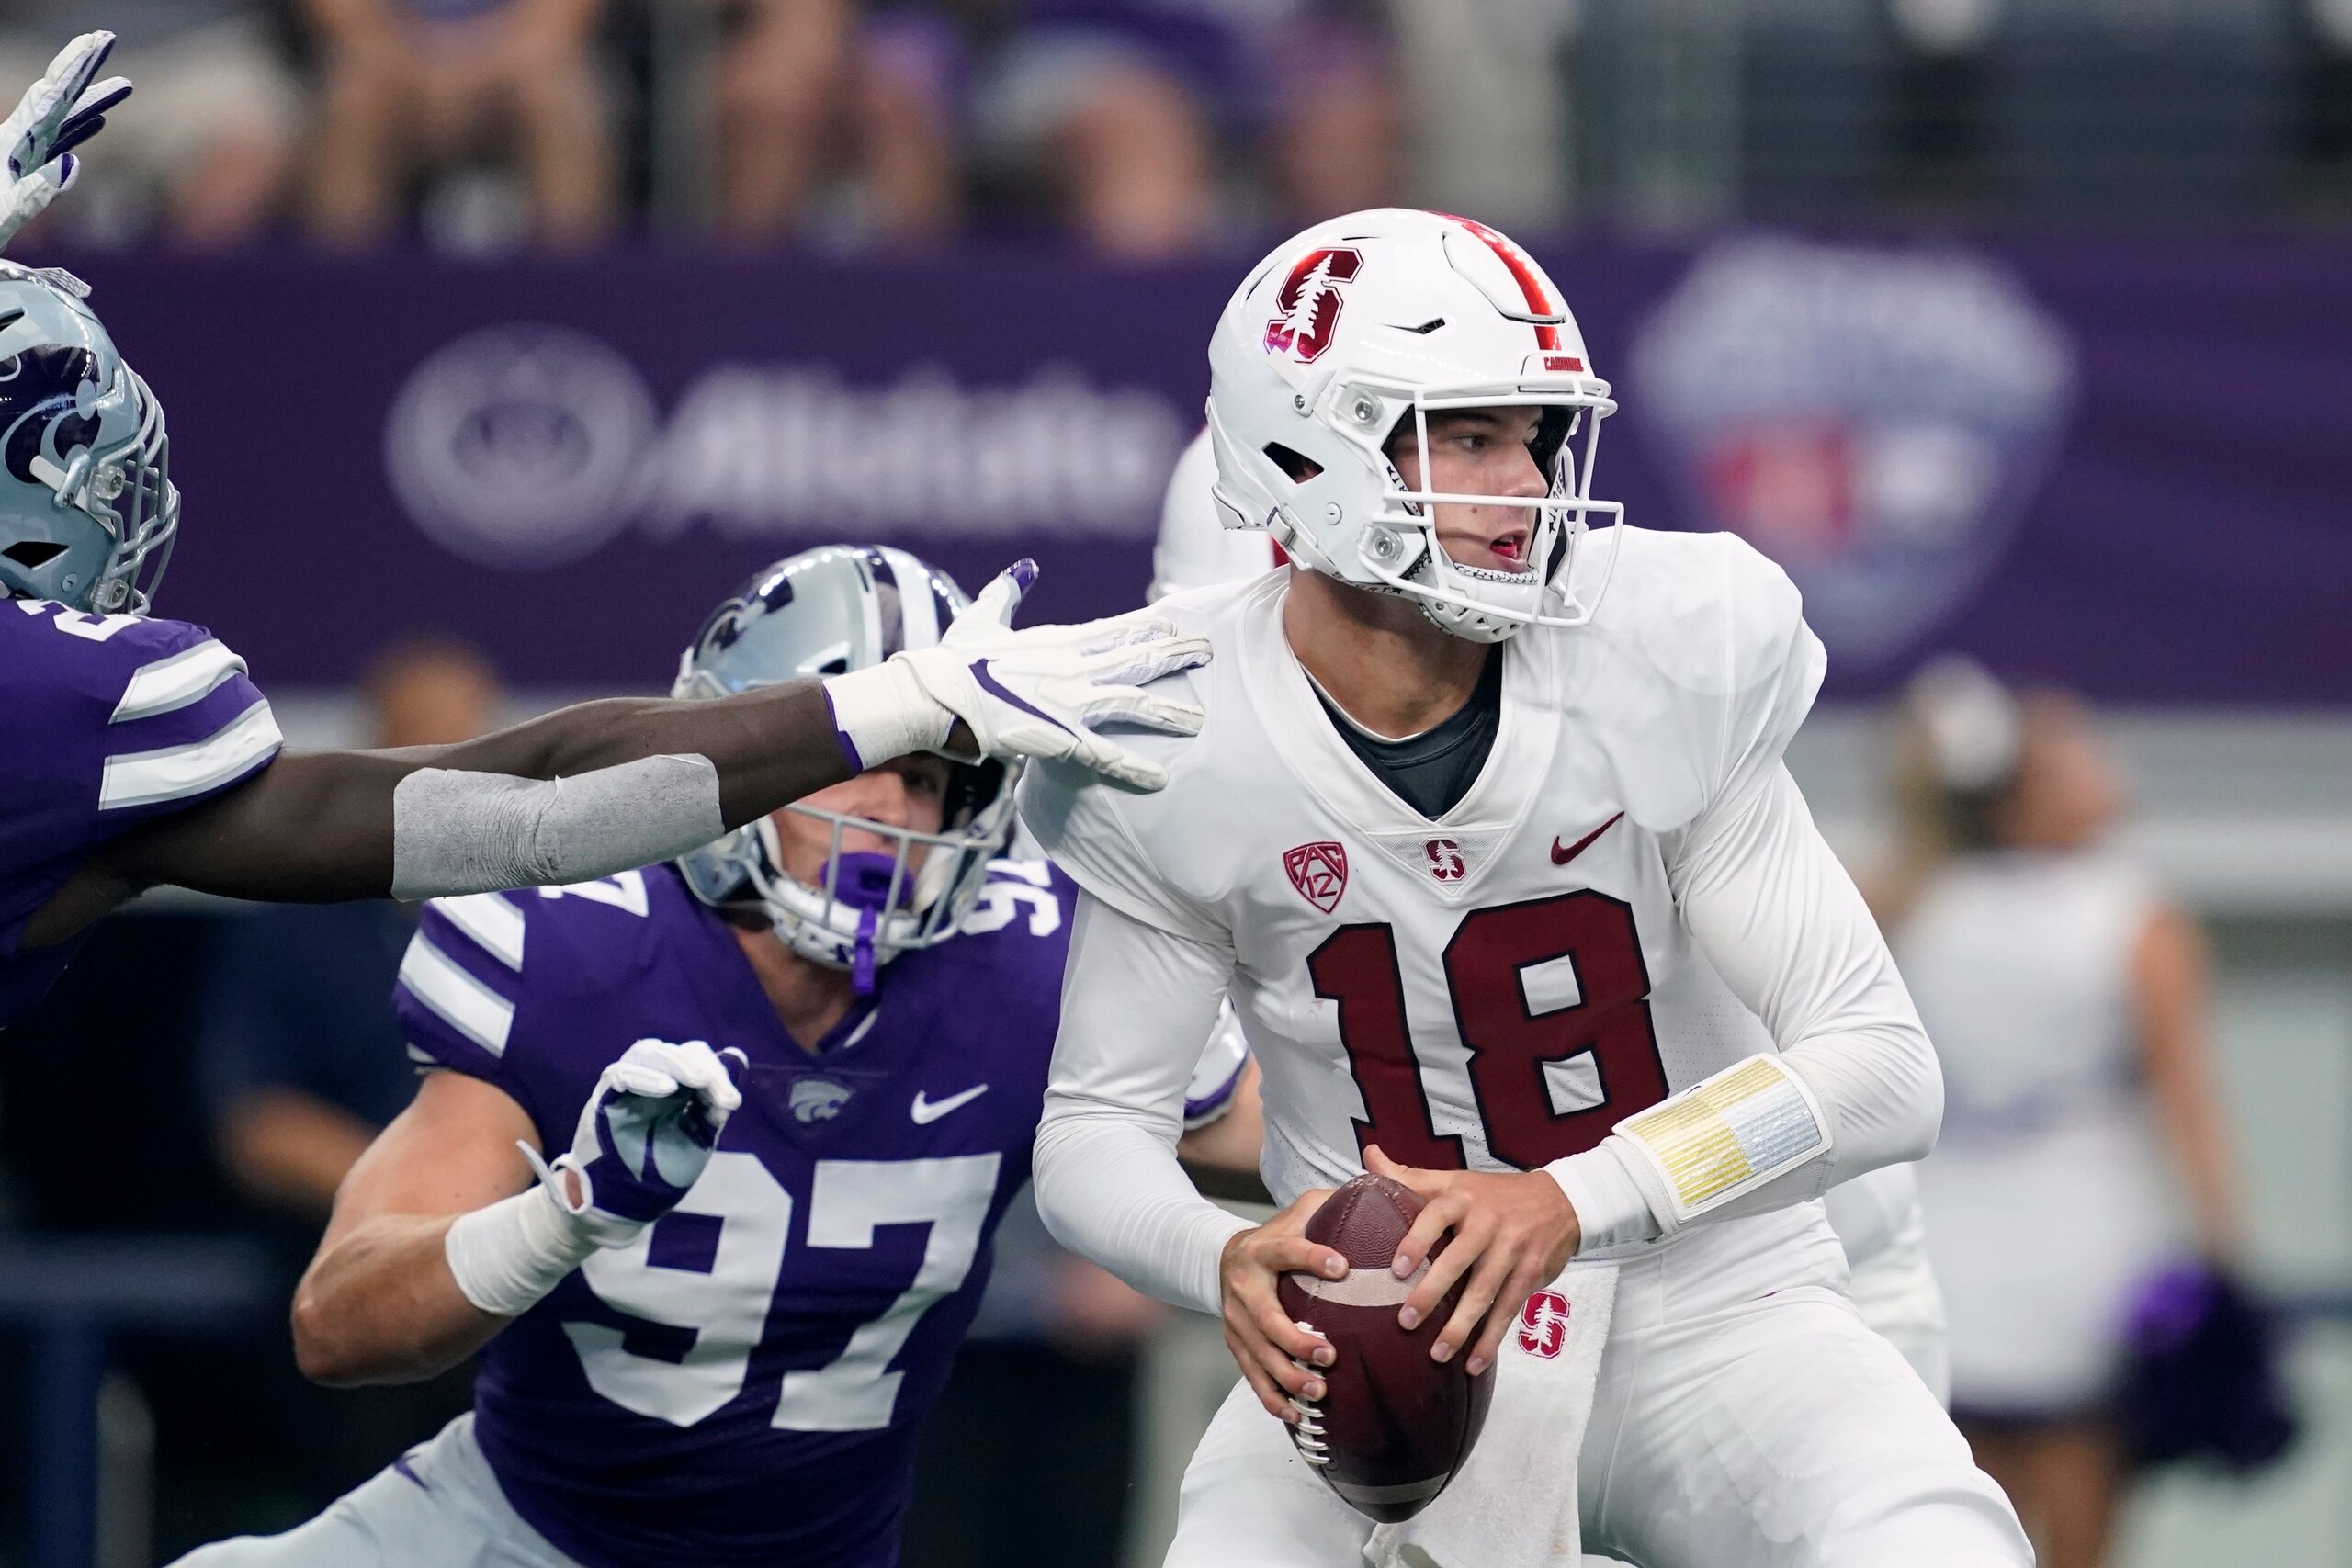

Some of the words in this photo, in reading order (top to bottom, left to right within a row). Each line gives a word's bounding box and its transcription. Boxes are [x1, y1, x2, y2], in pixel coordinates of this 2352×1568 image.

[1286, 845, 1343, 888] PAC
[1306, 872, 1339, 899] 12
[1306, 887, 1670, 1171] 18
[560, 1150, 1002, 1432] 97
